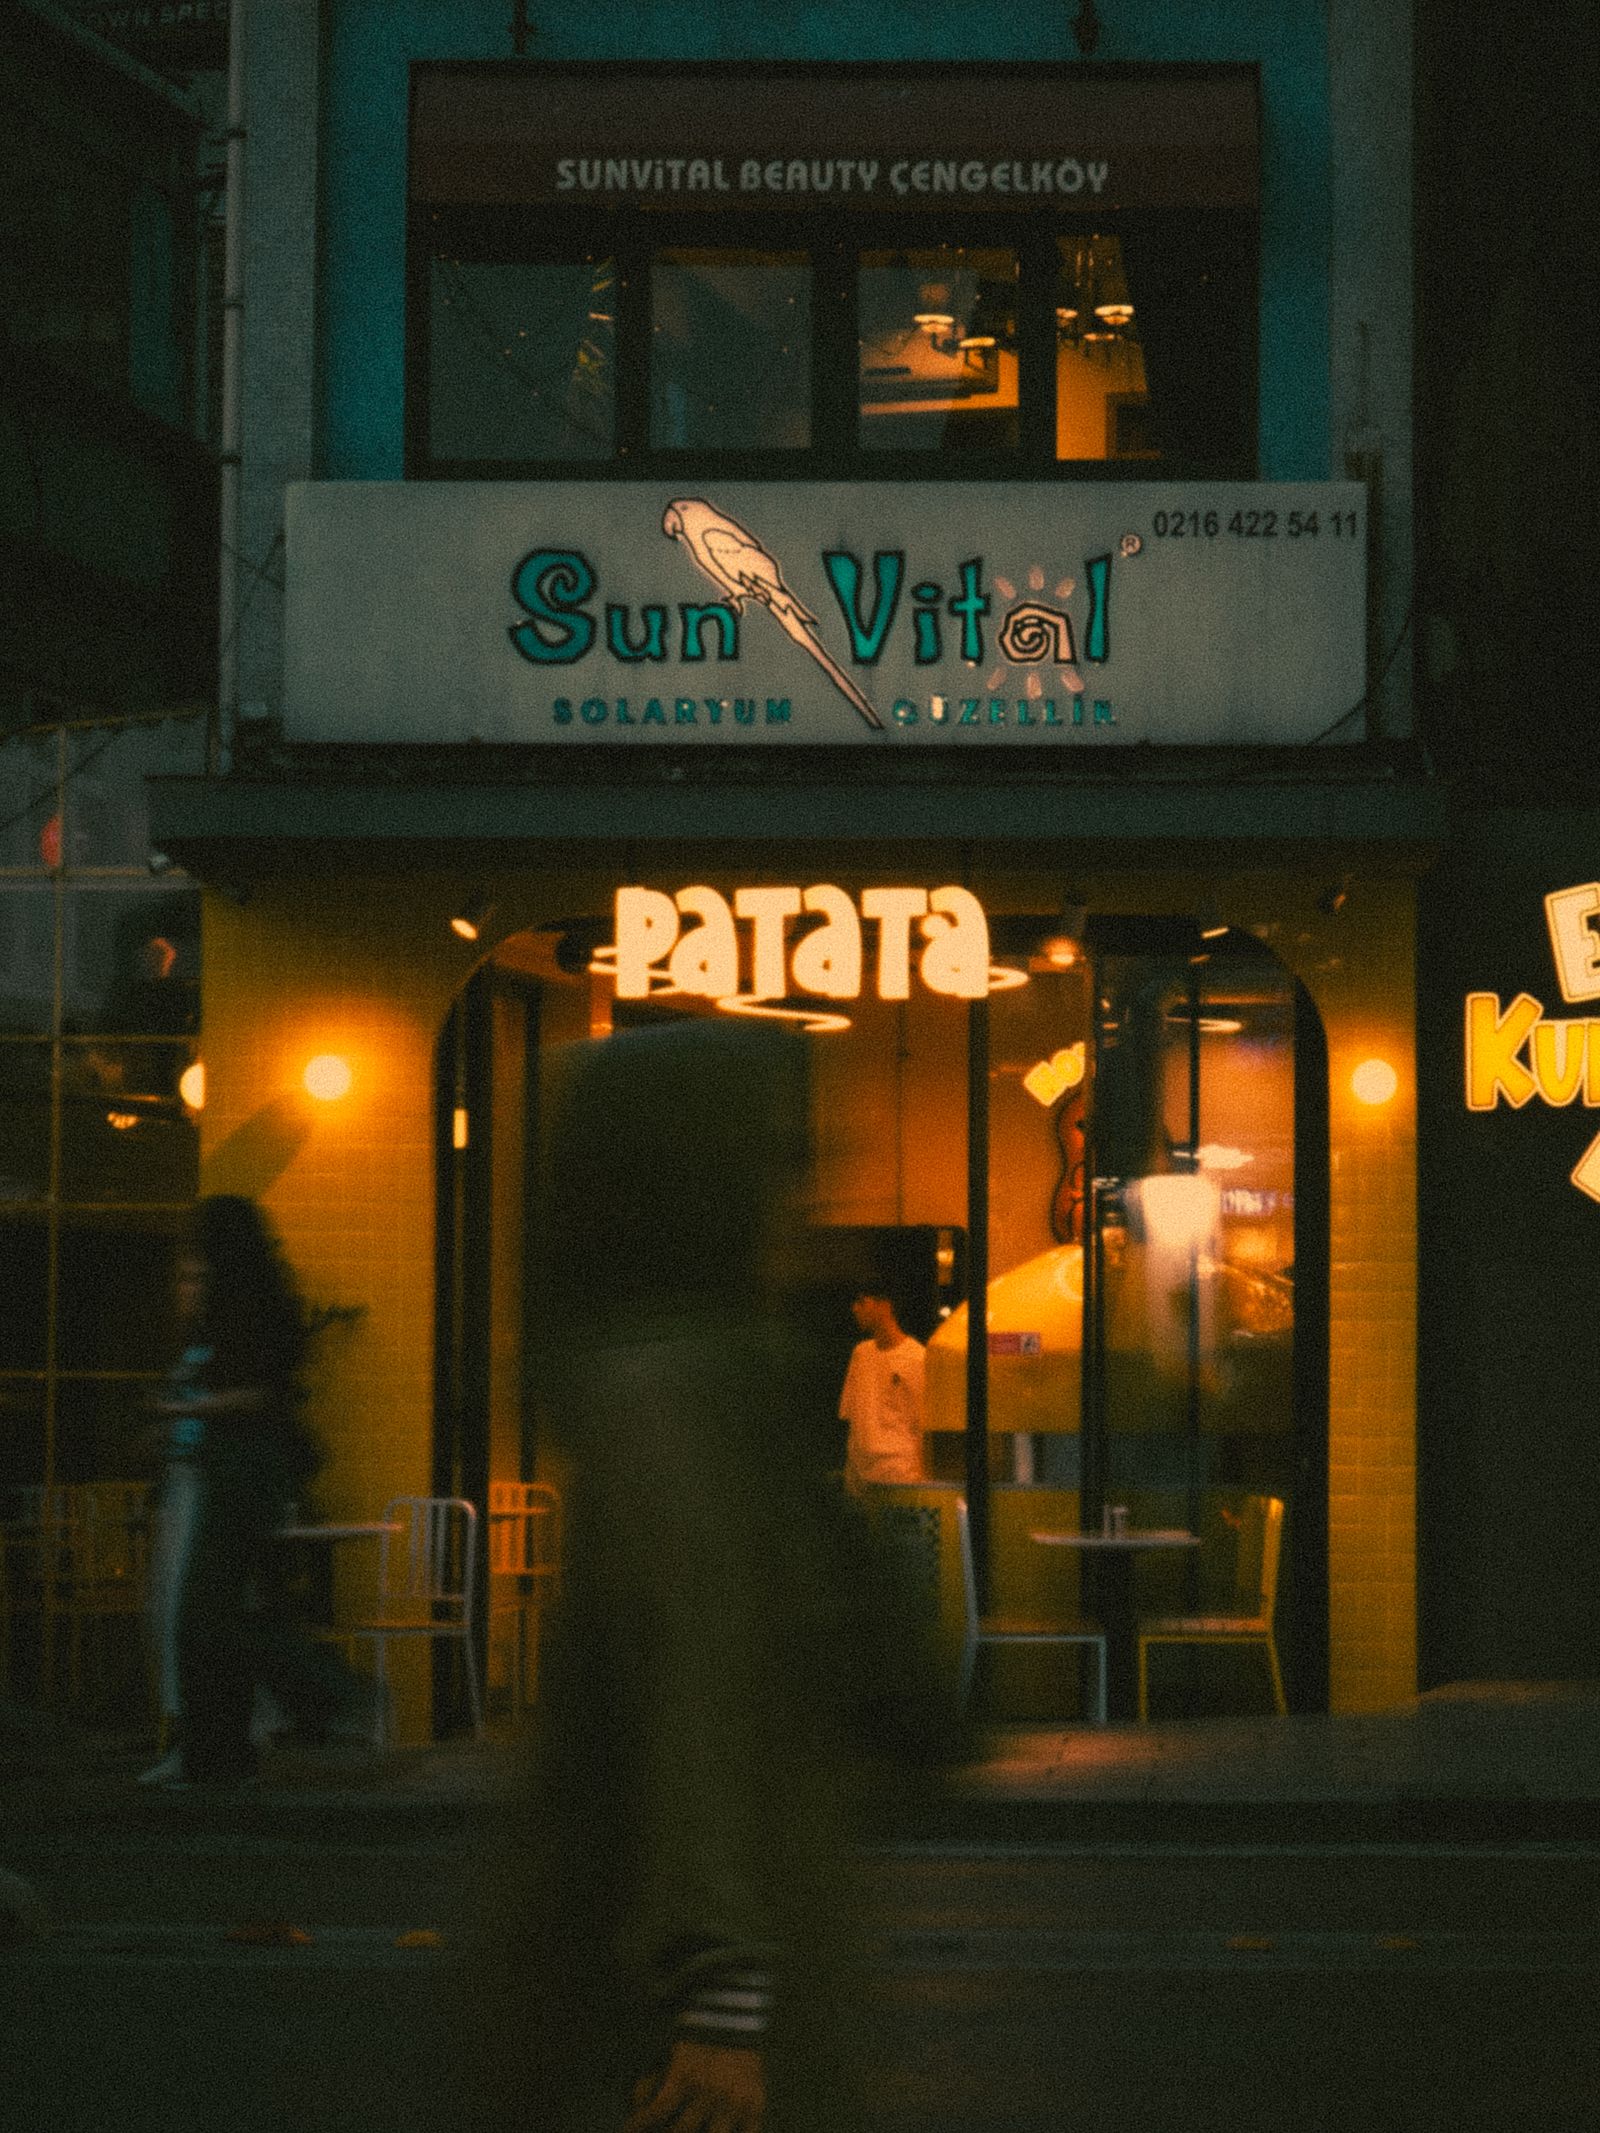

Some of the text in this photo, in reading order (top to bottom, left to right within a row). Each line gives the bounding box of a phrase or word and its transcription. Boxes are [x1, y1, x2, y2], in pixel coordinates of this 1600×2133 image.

[739, 159, 879, 191] BEAUTY
[889, 157, 1109, 195] ÇENGELKÖY
[1153, 510, 1357, 538] 0216 422 54 11
[508, 548, 740, 664] Sun
[822, 549, 1113, 665] Vital
[553, 697, 792, 726] SOLARYUM
